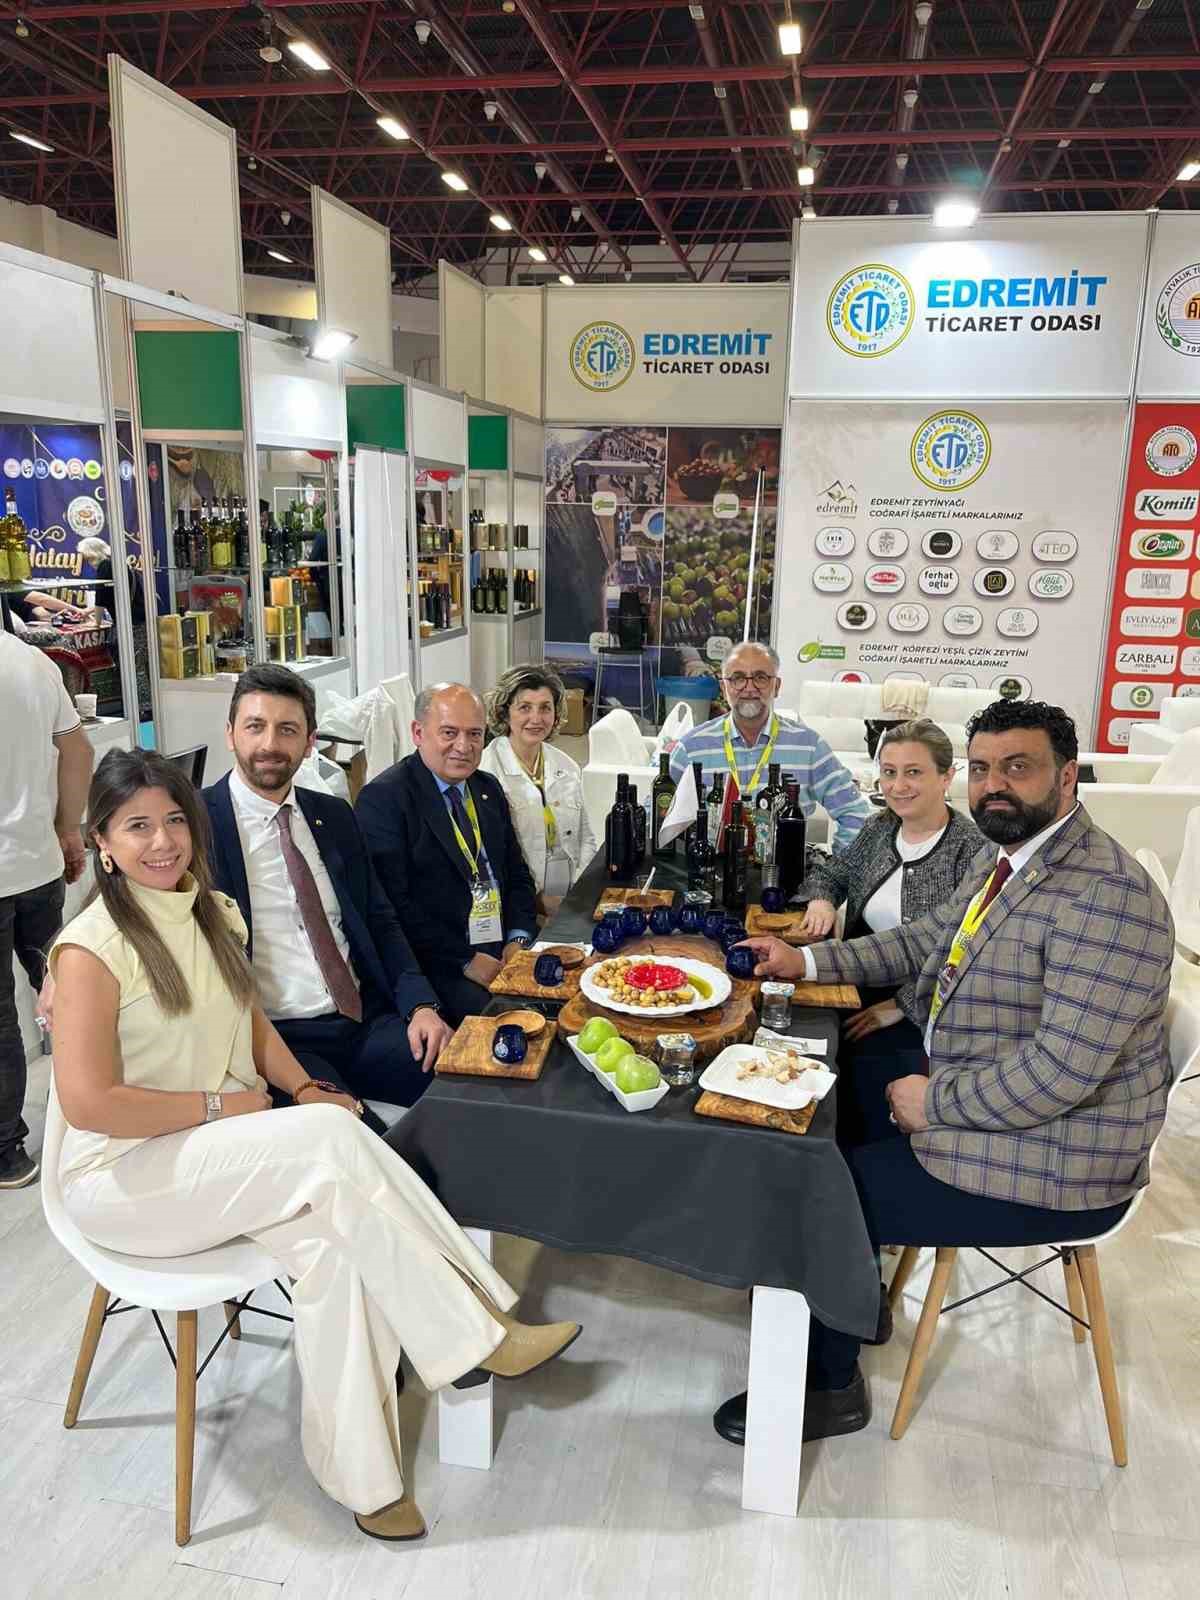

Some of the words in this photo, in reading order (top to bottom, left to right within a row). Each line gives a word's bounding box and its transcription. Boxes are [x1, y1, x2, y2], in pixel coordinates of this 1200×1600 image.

[927, 269, 1107, 308] EDREMİT
[1164, 270, 1192, 297] AYVALIK
[925, 313, 1024, 333] TİCARET
[1030, 314, 1101, 331] ODASI
[643, 327, 773, 355] EDREMİT
[857, 343, 877, 351] 1917
[643, 358, 714, 374] TİCARET
[719, 361, 770, 374] ODASI
[912, 497, 965, 507] ZEYTİNYAĞI
[1140, 495, 1196, 516] Komili
[869, 508, 910, 518] COĞRAFİ
[910, 508, 952, 520] İŞARETLİ
[952, 511, 1024, 520] MARKALARIMIZ
[924, 571, 953, 580] ferhat
[928, 580, 949, 590] oglu
[939, 658, 1009, 668] MARKALARIMIZ
[1119, 653, 1174, 664] ZARBALI
